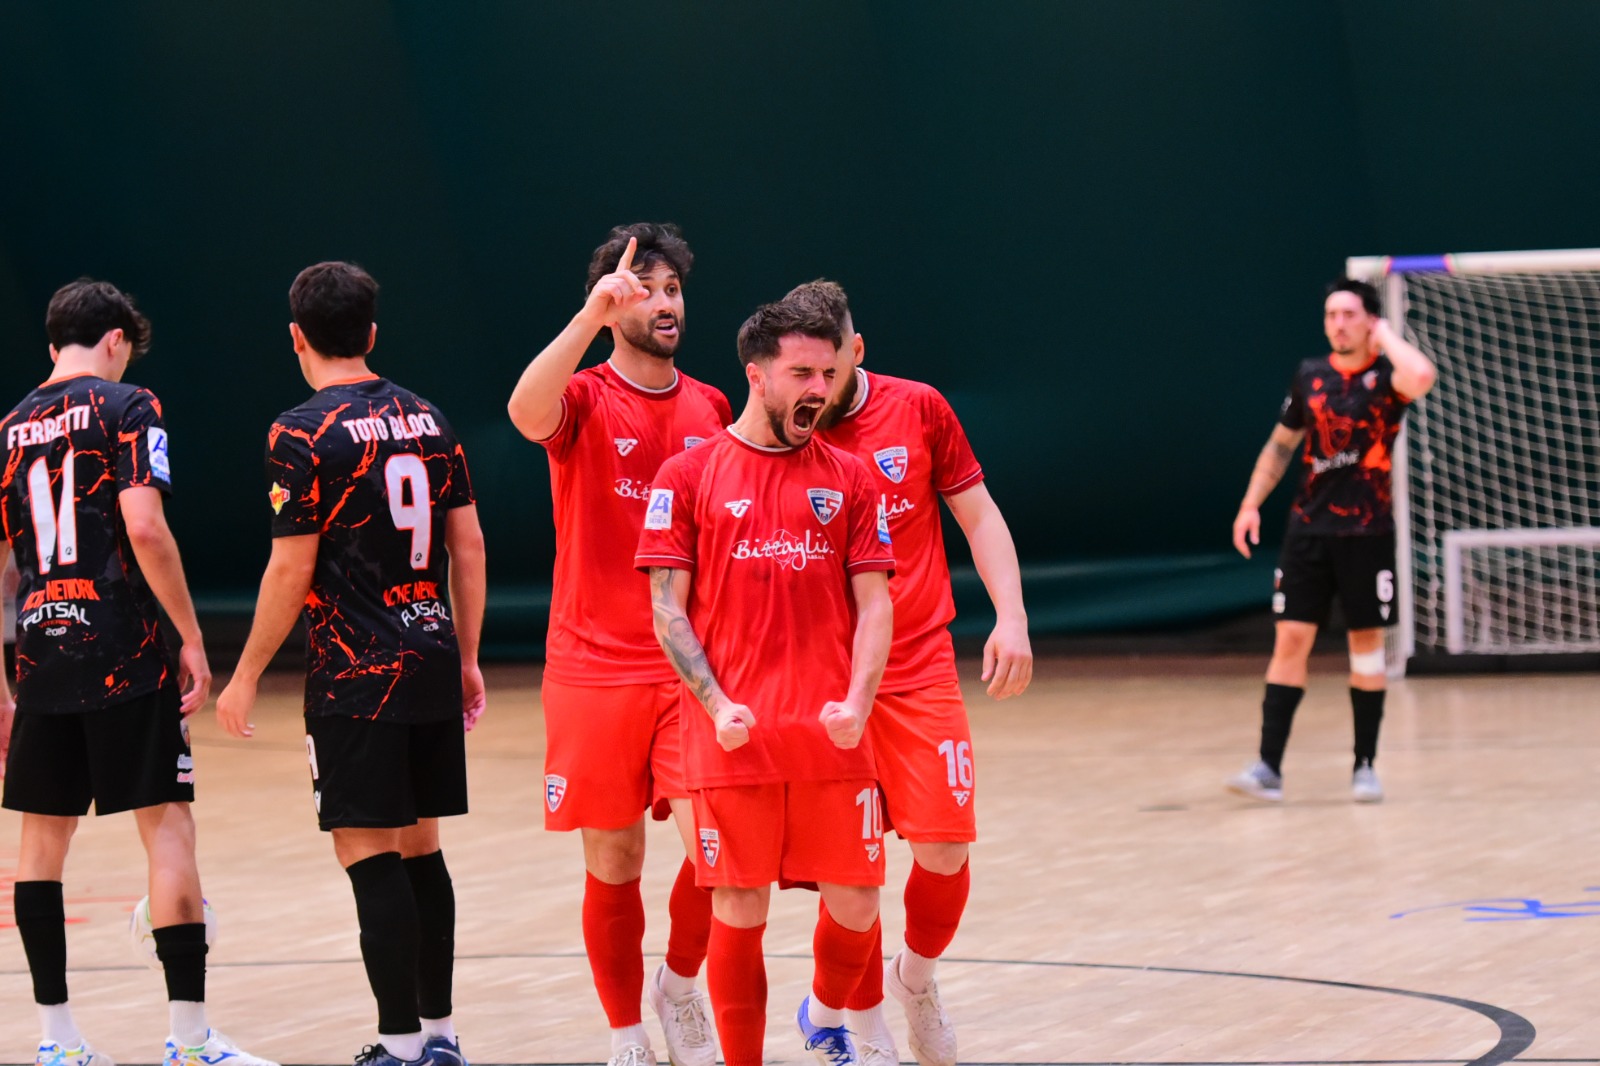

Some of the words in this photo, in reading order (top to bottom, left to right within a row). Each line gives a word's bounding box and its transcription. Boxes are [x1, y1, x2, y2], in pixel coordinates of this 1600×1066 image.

[7, 405, 91, 450] FERRETTI
[342, 417, 389, 443] TOTO
[27, 449, 78, 575] 11
[384, 453, 432, 571] 9
[1376, 569, 1394, 603] 6
[23, 602, 91, 632] FUTSAL
[937, 739, 974, 789] 16
